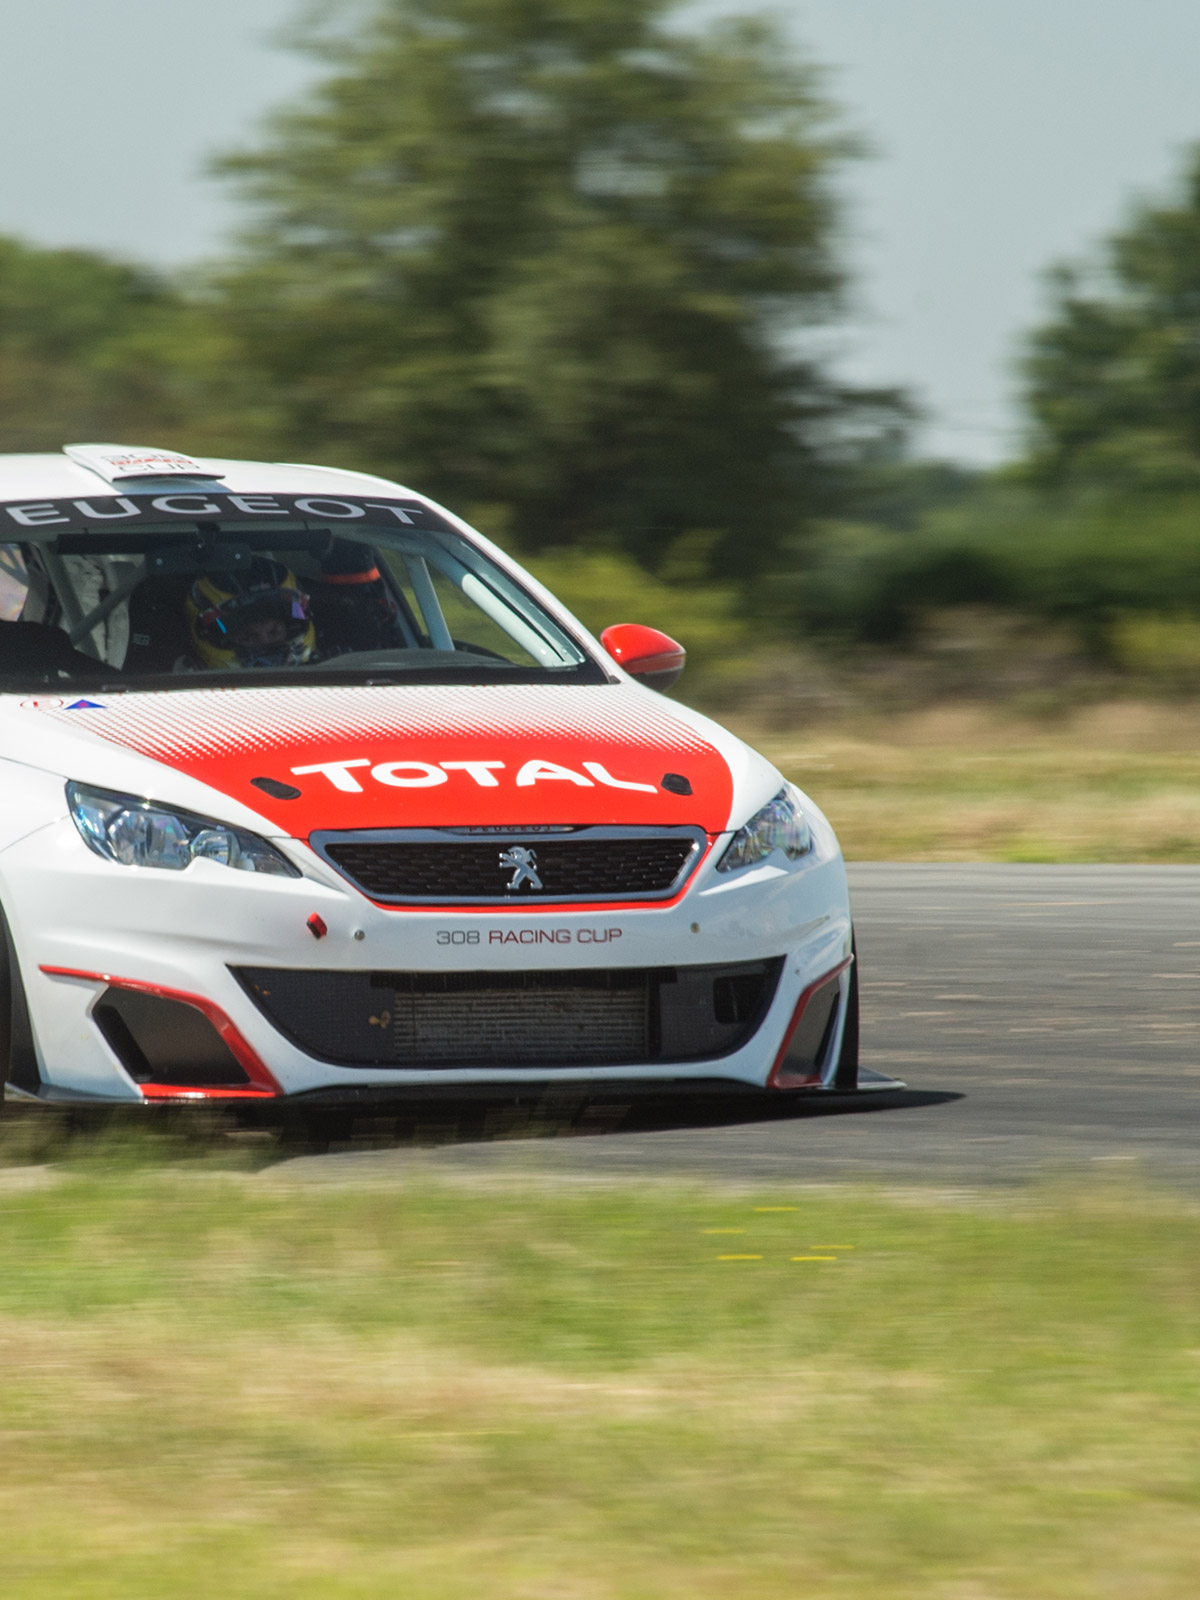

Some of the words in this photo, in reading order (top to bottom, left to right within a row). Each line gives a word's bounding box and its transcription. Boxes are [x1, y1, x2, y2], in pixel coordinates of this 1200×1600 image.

[290, 758, 658, 794] TOTAL
[436, 930, 480, 945] 308
[488, 929, 571, 944] RACING
[576, 928, 623, 943] CUP
